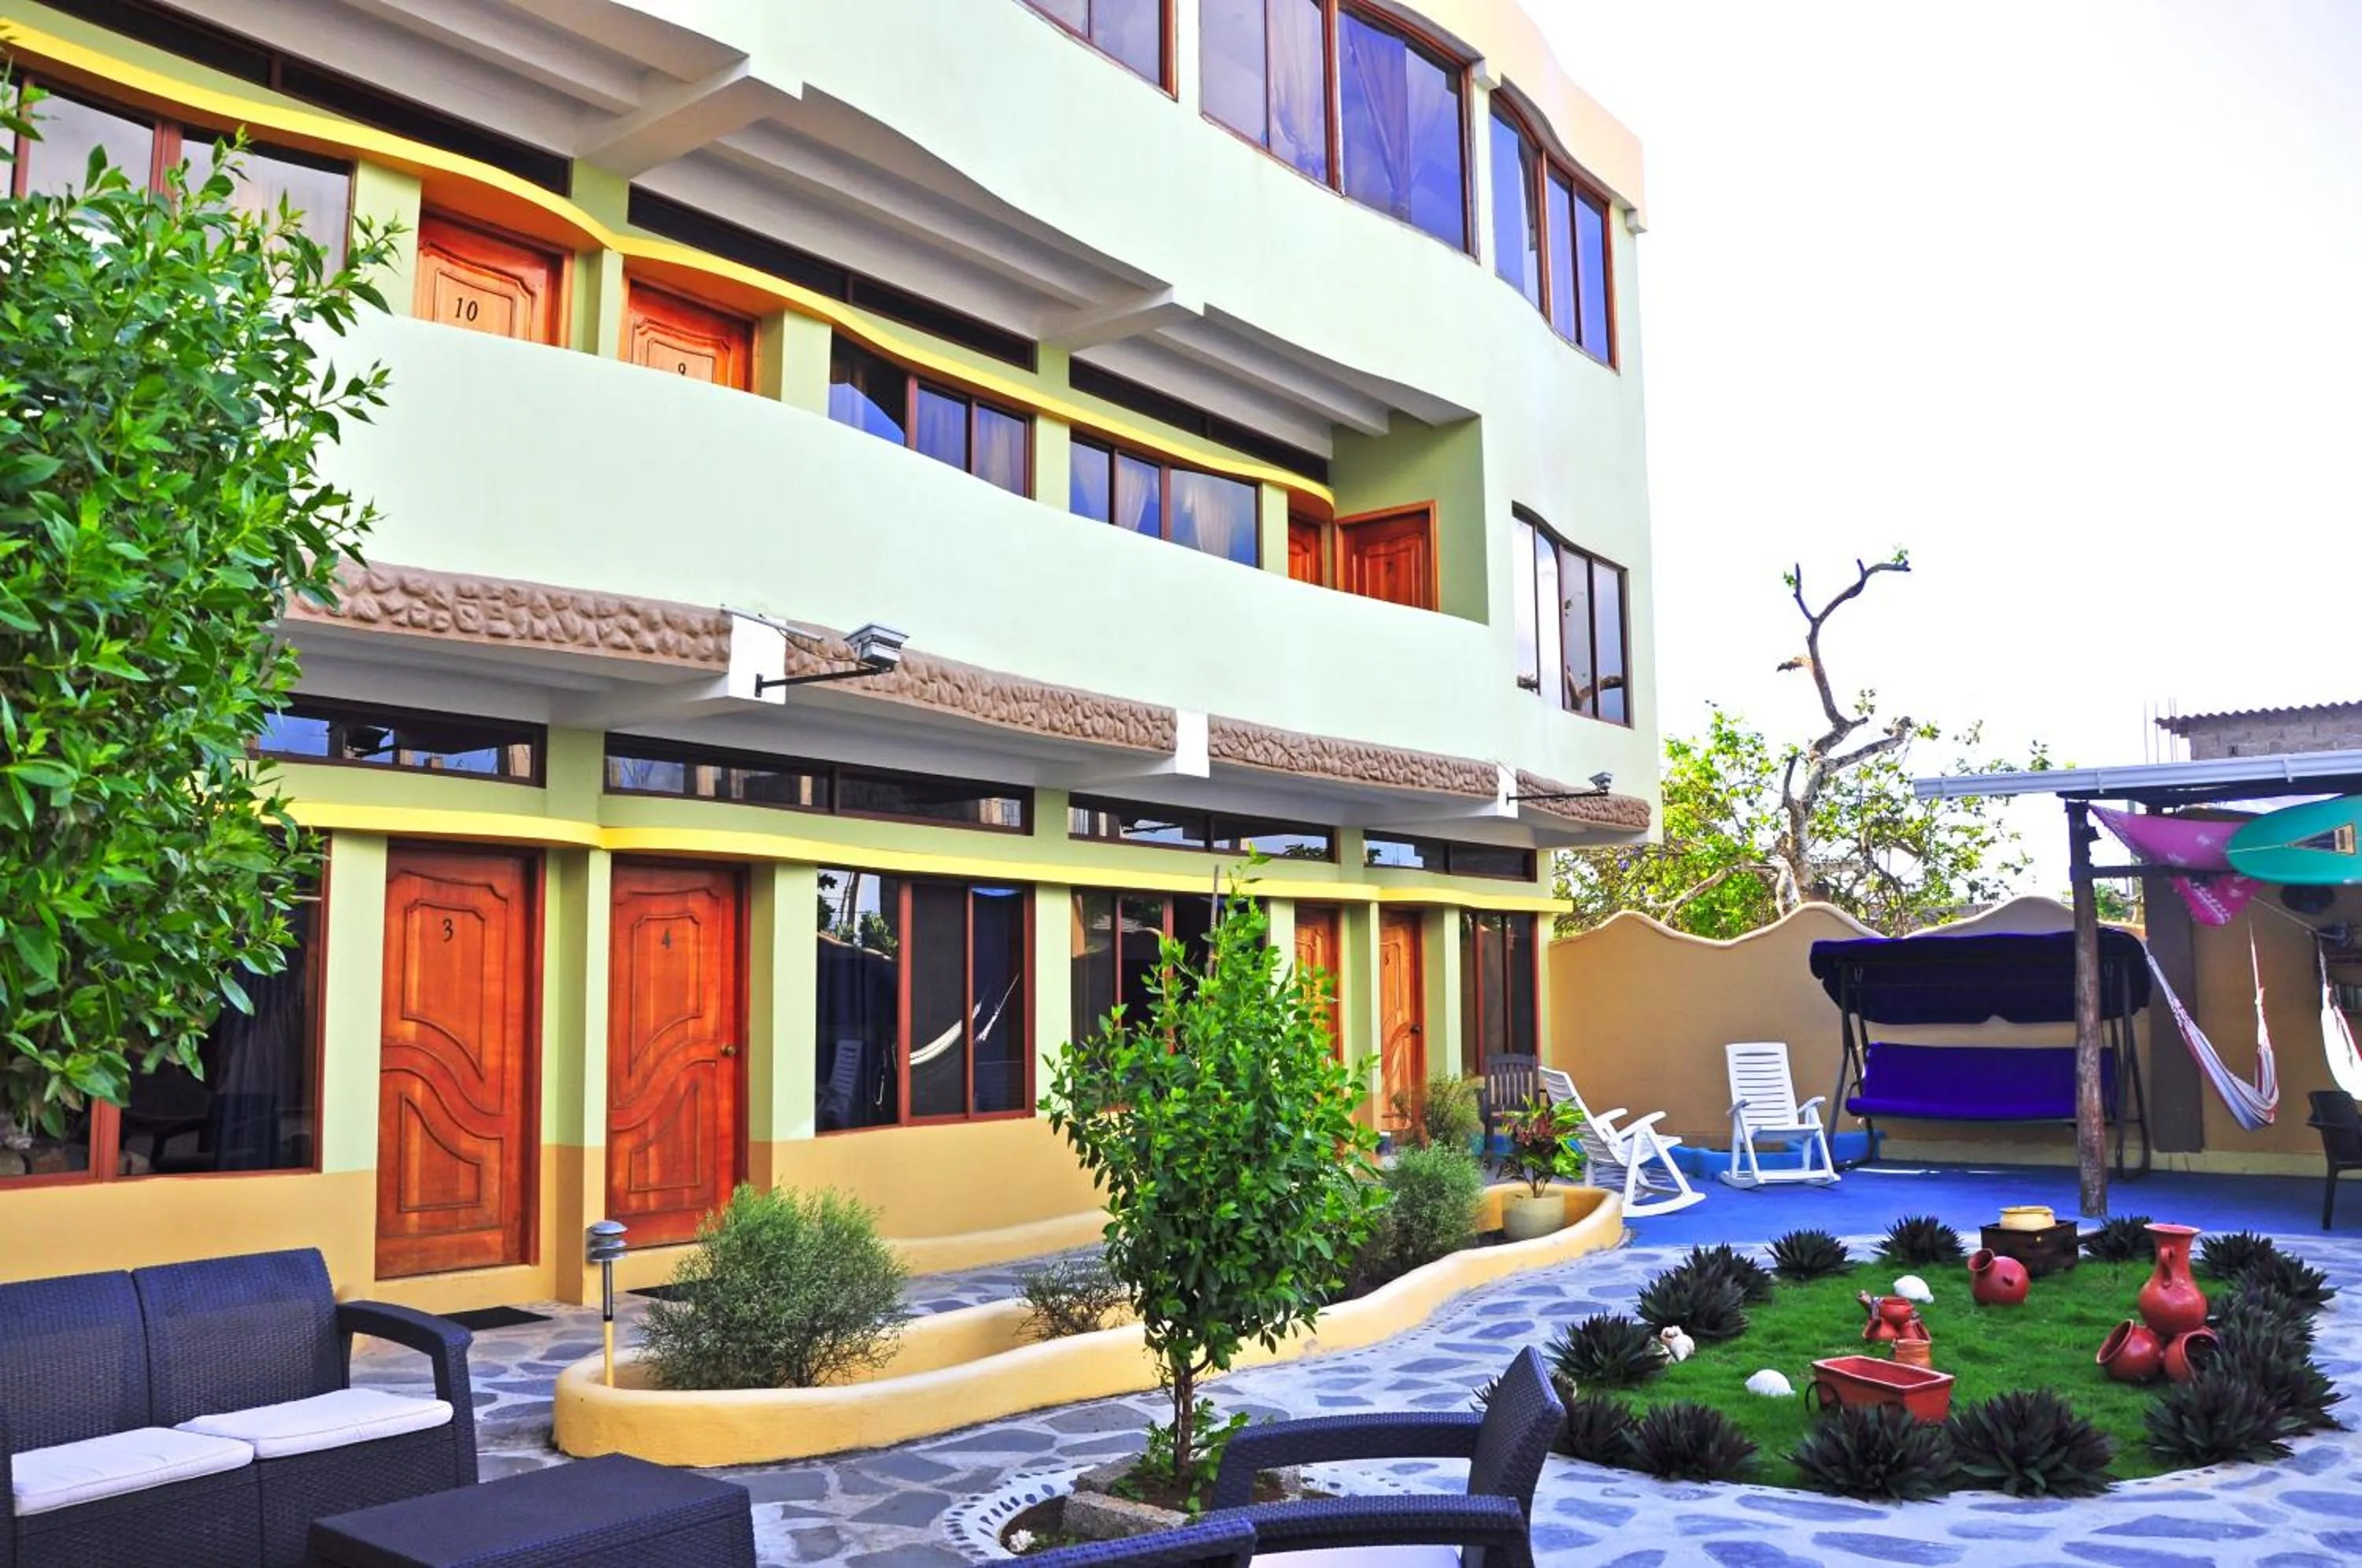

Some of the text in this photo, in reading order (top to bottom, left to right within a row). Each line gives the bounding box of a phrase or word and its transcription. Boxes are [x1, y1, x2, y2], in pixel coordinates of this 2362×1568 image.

[455, 297, 478, 322] 10
[443, 918, 454, 943] 3
[661, 927, 671, 950] 4
